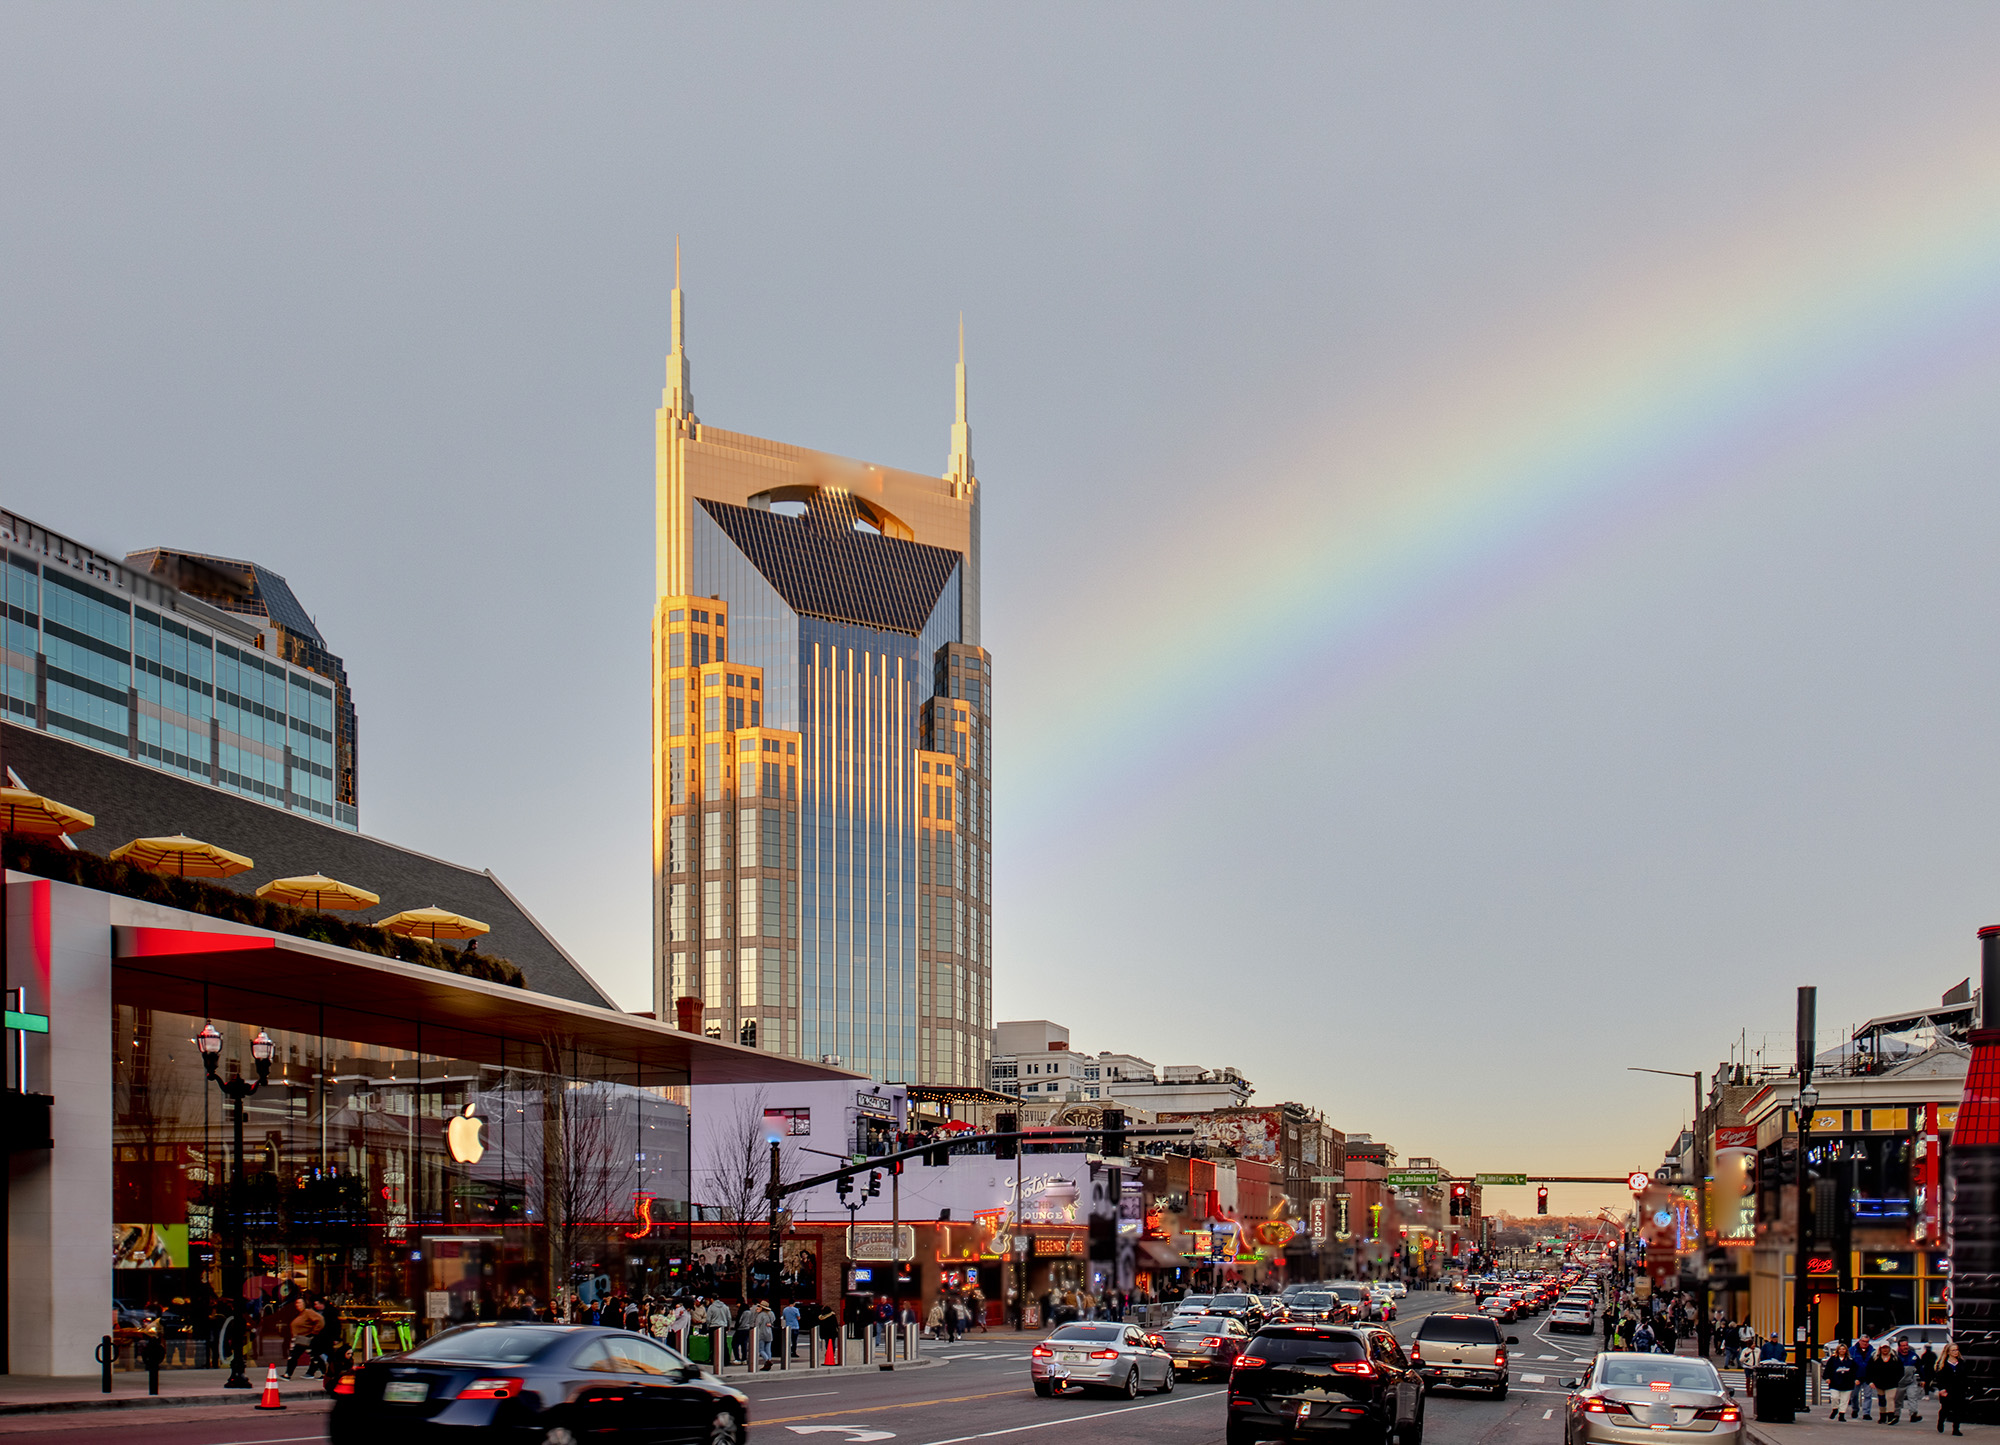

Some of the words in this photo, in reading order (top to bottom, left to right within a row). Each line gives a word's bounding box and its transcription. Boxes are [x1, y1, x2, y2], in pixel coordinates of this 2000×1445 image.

[1719, 1127, 1756, 1144] Rippy's
[1314, 1204, 1323, 1237] SALOON
[1037, 1240, 1065, 1252] LEGENDS
